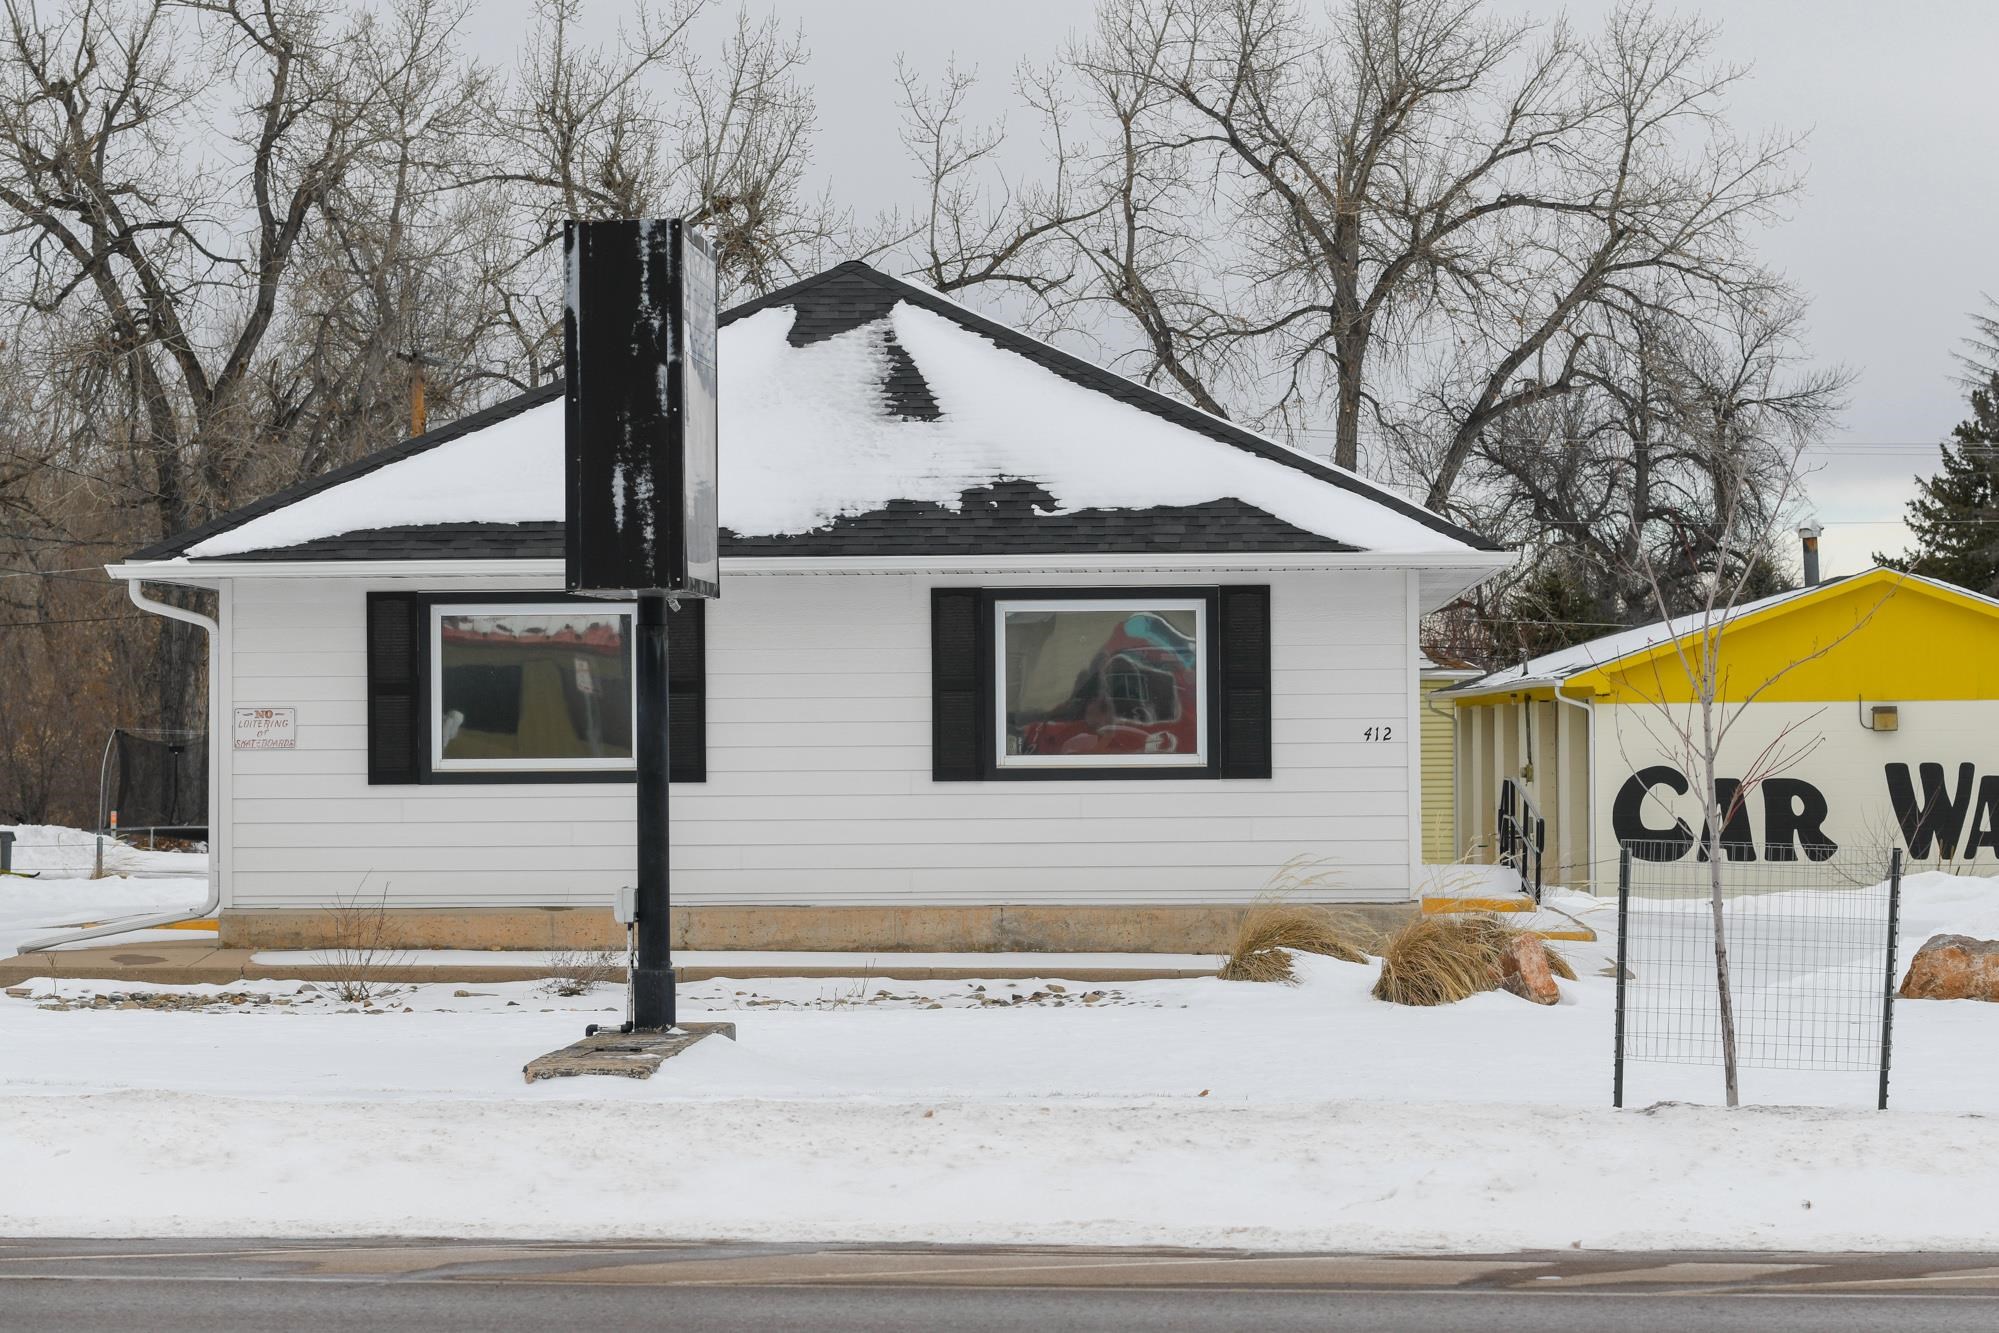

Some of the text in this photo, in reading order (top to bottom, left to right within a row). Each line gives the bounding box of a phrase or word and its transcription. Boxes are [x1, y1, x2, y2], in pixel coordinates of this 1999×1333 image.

[254, 709, 273, 719] NO
[238, 719, 289, 729] LOITERING
[1364, 726, 1392, 742] 412
[1612, 765, 1838, 862] CAR
